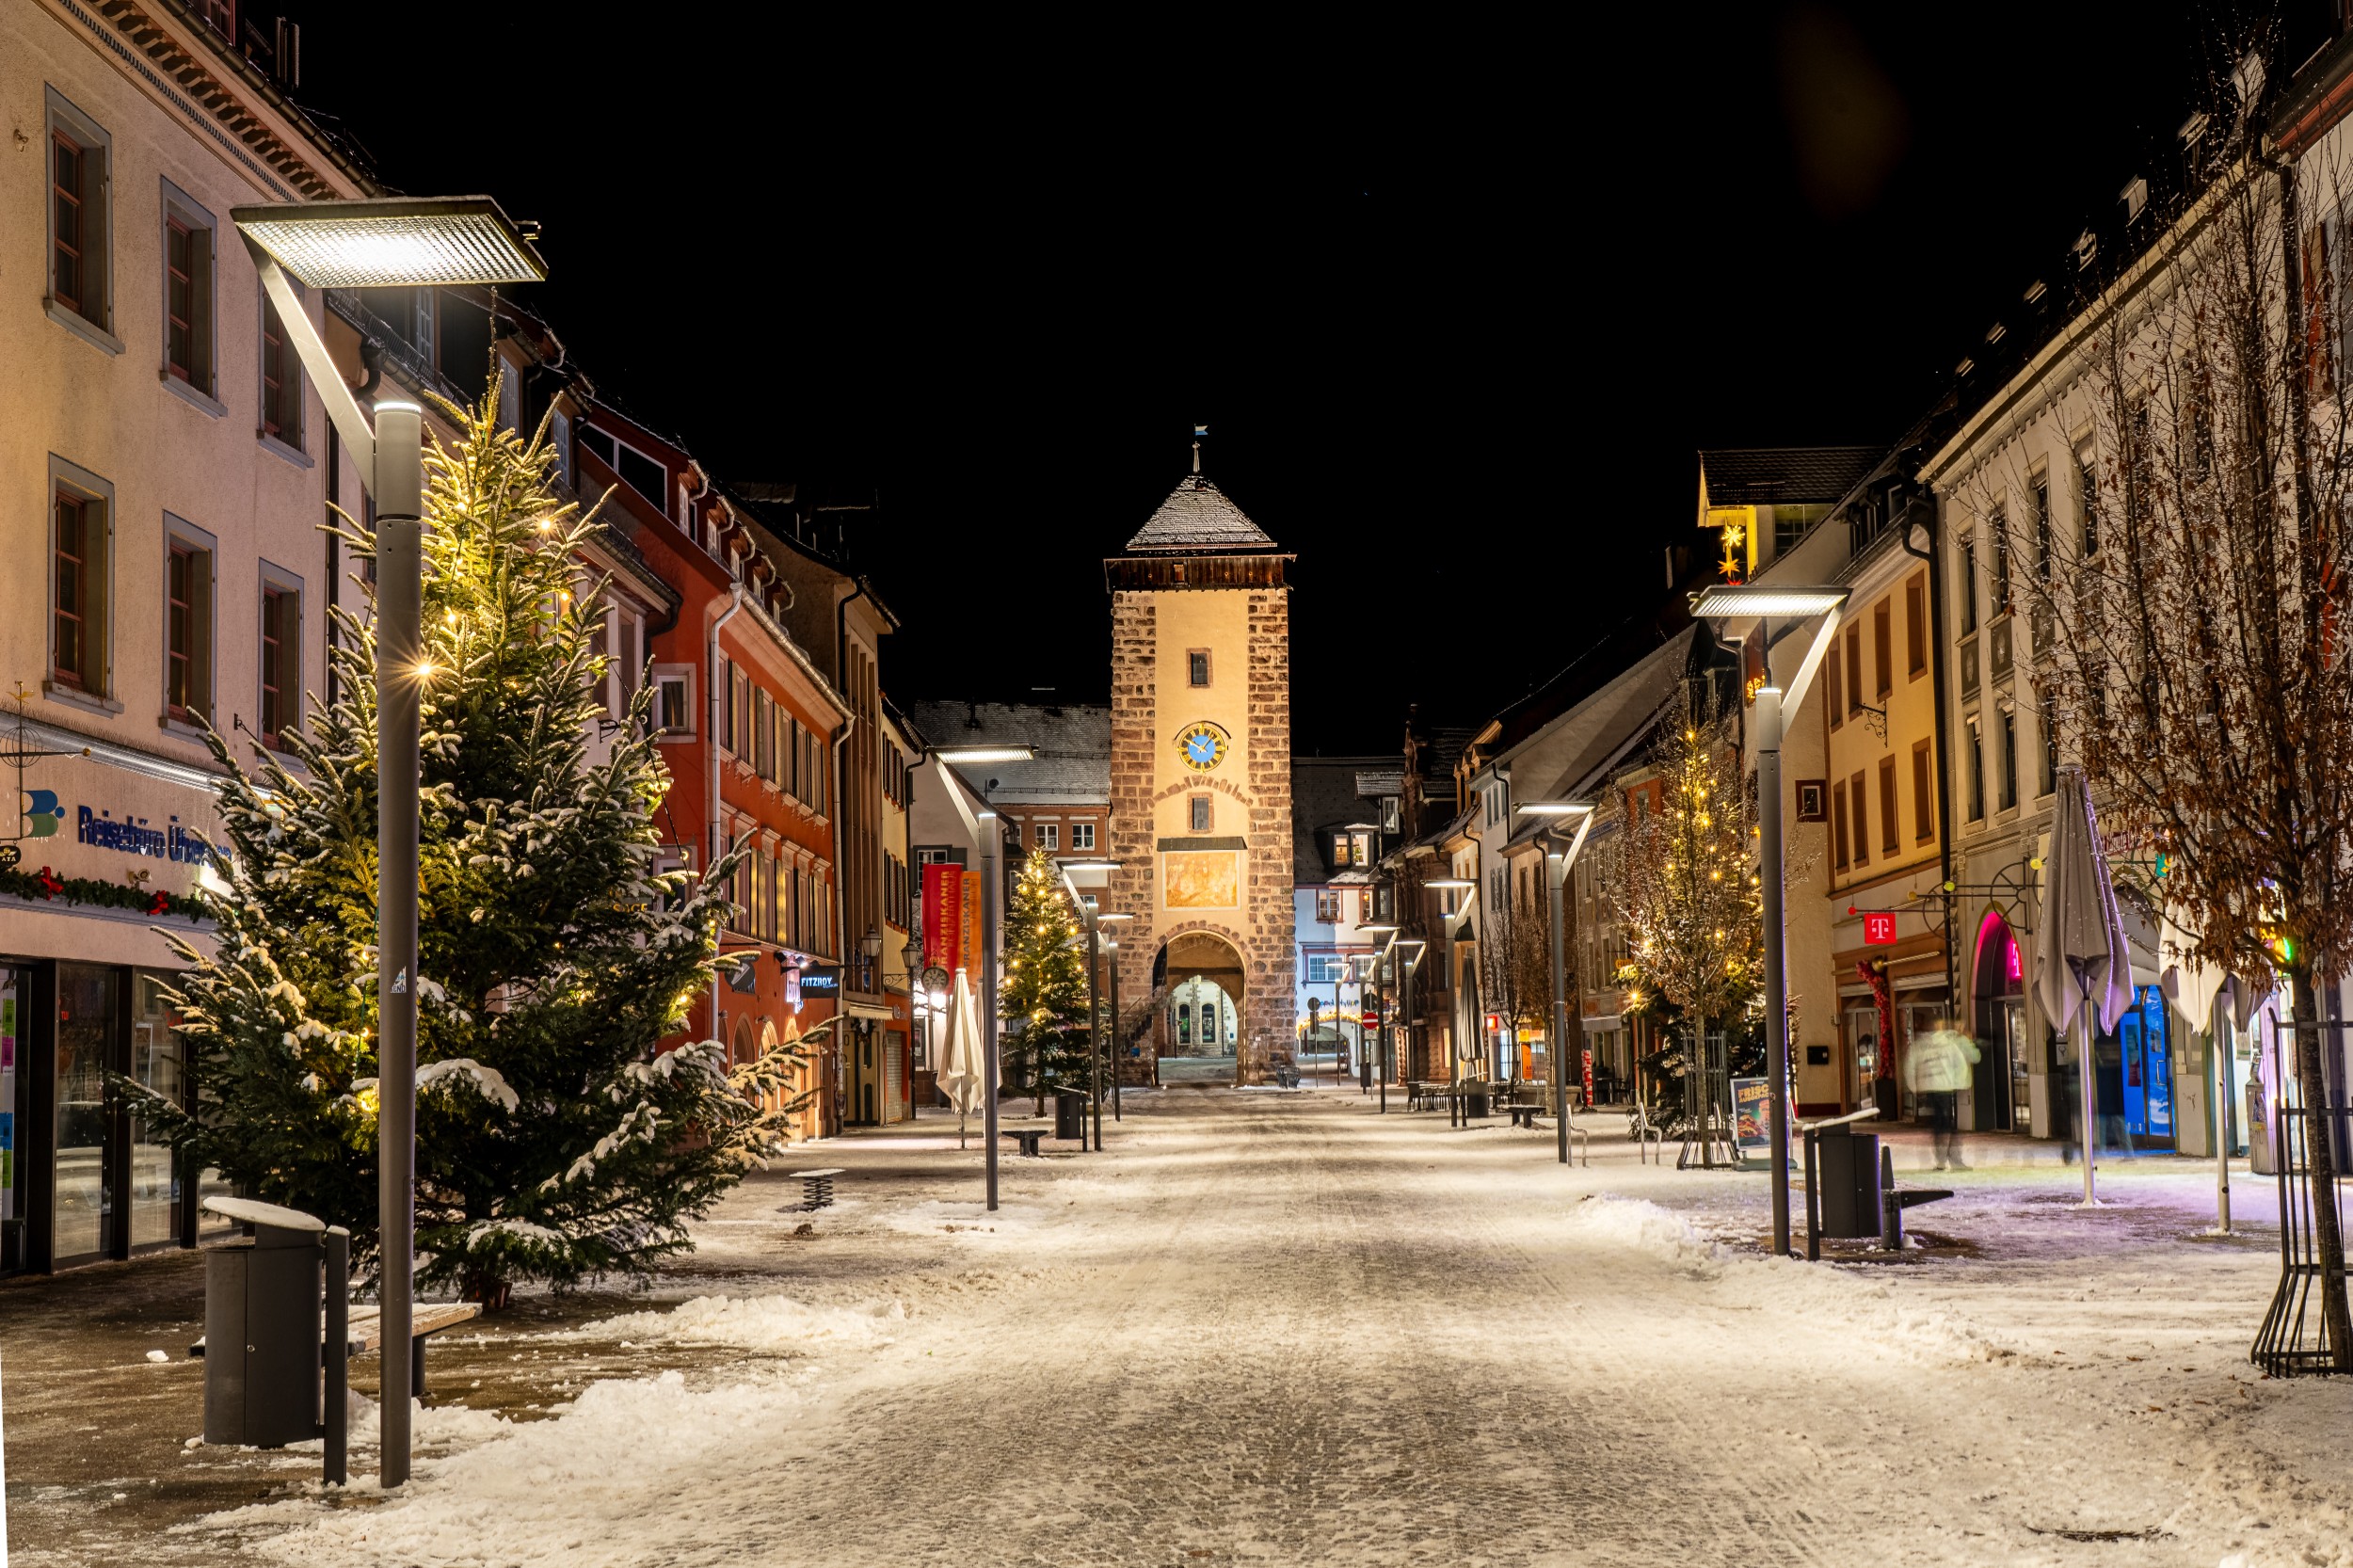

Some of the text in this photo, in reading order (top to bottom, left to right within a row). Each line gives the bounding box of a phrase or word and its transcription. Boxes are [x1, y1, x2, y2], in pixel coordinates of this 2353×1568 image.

[78, 805, 166, 858] Reisebüro
[801, 976, 833, 987] FITZROY
[1737, 1083, 1769, 1098] FRISC
